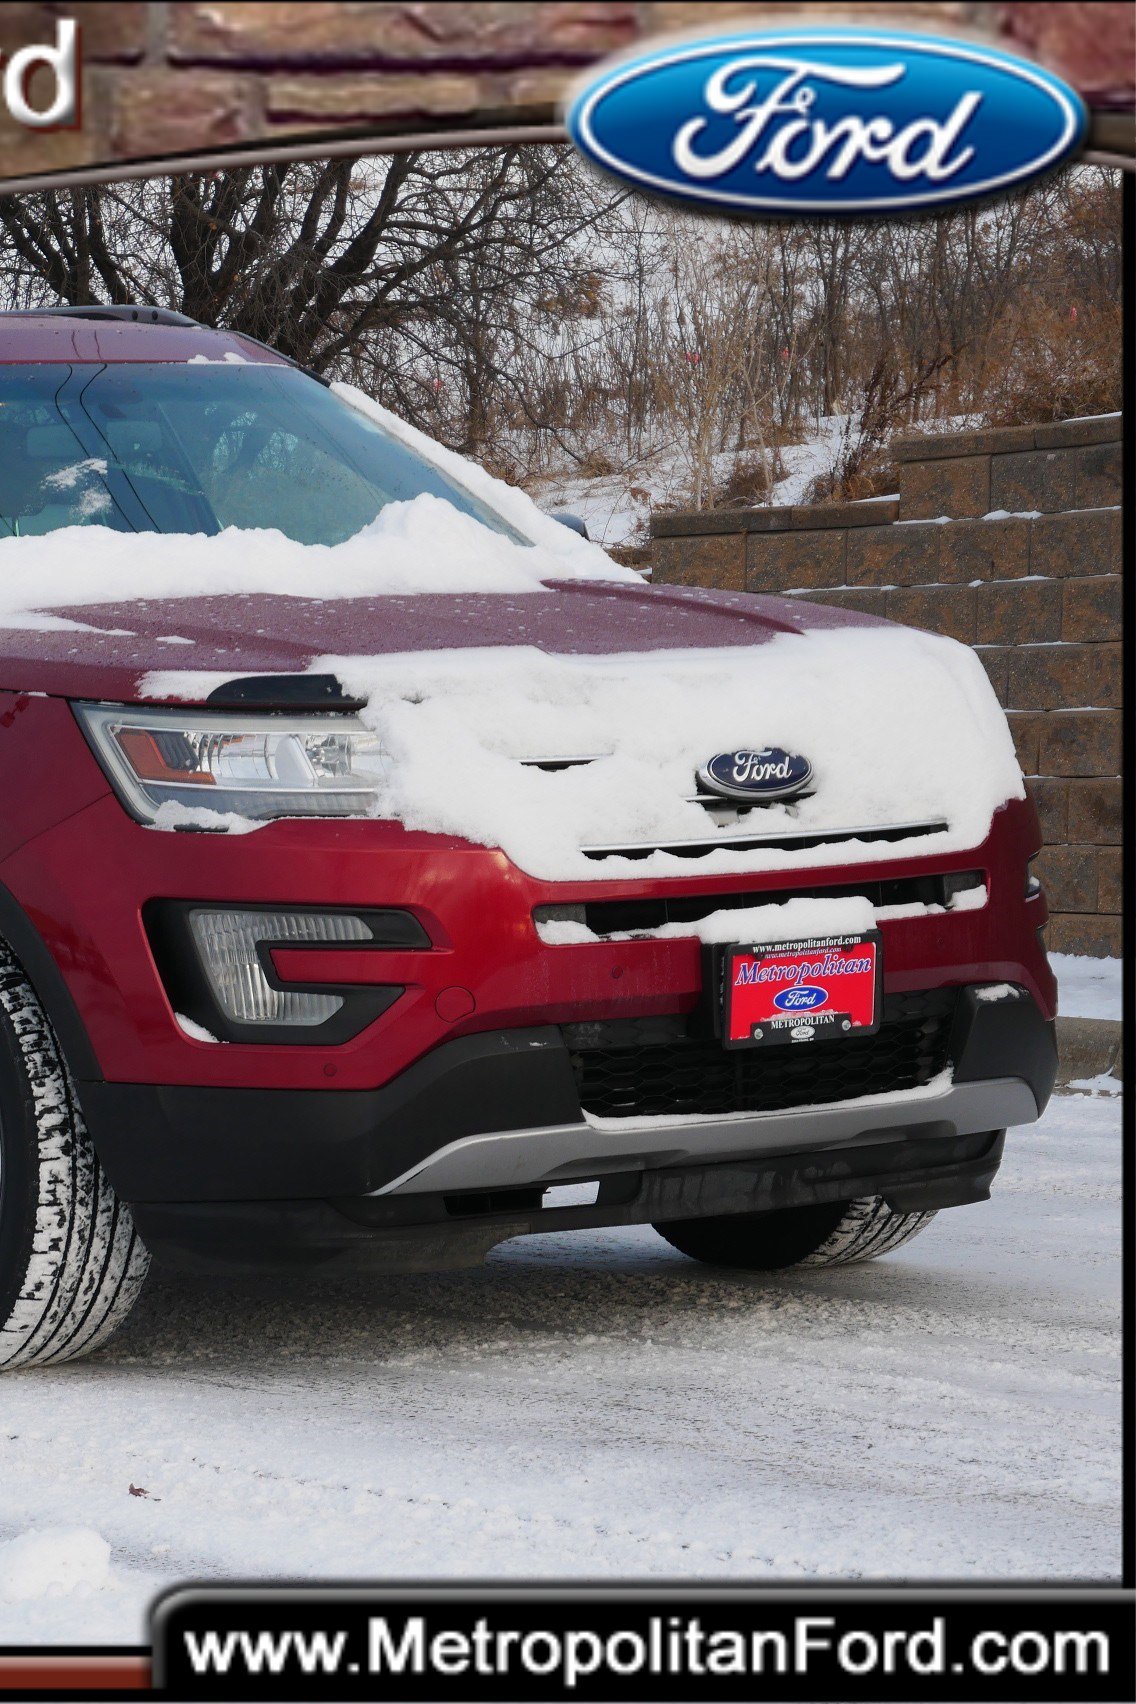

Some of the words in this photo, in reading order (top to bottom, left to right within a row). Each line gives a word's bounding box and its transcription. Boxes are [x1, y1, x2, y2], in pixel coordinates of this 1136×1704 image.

[732, 750, 793, 782] Ford
[752, 936, 862, 954] www.metropolitanford.com
[734, 953, 872, 986] Metropolitan
[784, 990, 816, 1006] Ford
[771, 1014, 835, 1030] METROPOLITAN
